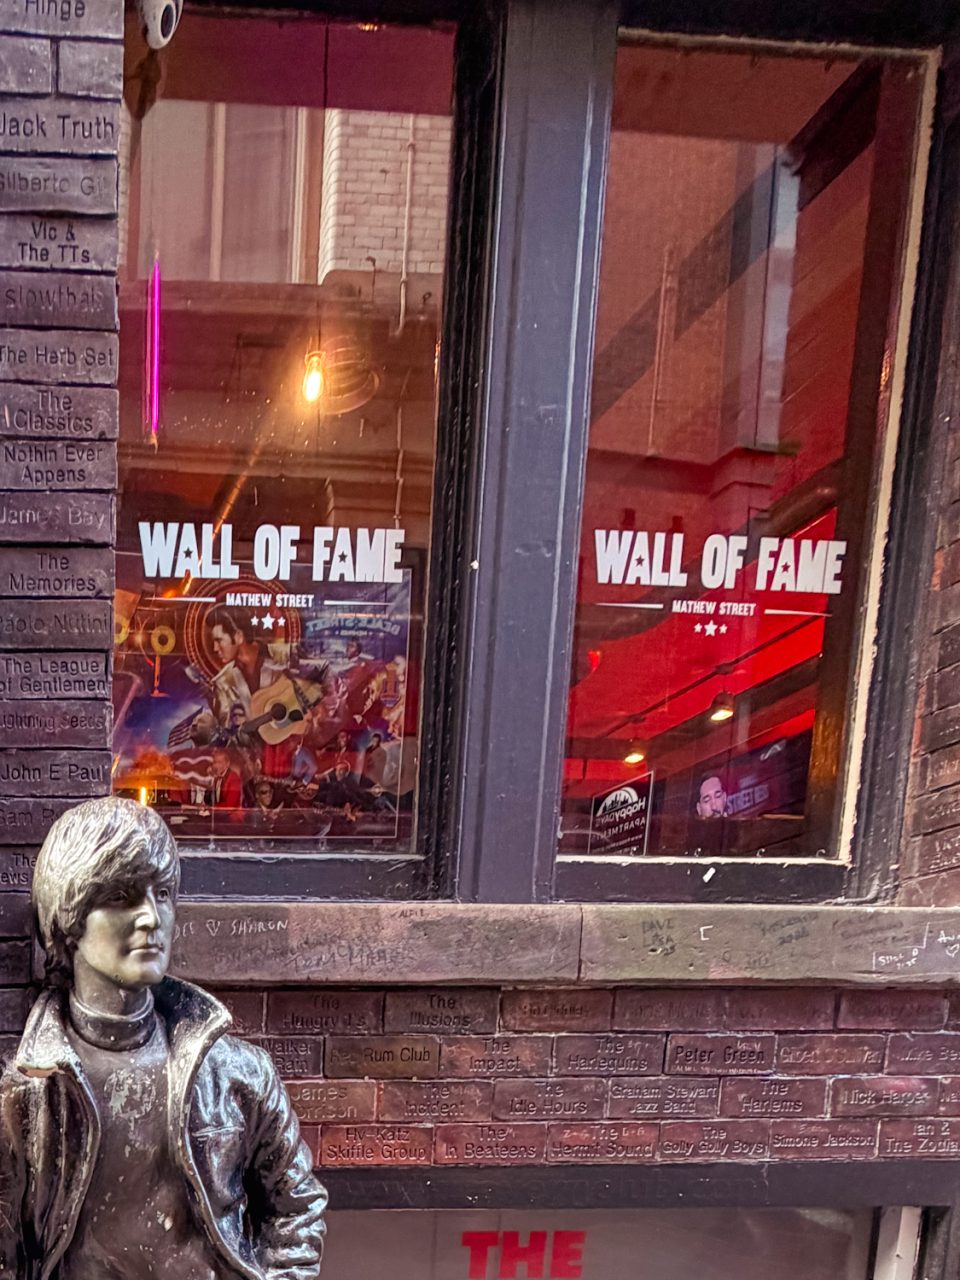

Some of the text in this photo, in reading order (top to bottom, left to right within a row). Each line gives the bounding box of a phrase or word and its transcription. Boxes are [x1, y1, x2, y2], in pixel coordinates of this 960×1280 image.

[57, 115, 115, 140] Truth
[32, 222, 76, 241] Vic &
[18, 243, 91, 263] The TTs
[35, 346, 77, 366] Herb
[84, 348, 114, 366] Set
[38, 390, 72, 411] The
[14, 408, 93, 432] Classics
[5, 446, 103, 463] Nothin Ever
[22, 466, 86, 486] Appens
[139, 522, 406, 583] WALL OF FAME
[37, 553, 70, 570] The
[594, 529, 847, 594] WALL OF FAME
[9, 573, 96, 592] Memories
[226, 593, 314, 608] MATHEW STREET
[672, 600, 757, 617] MATHEW STREET
[2, 657, 100, 677] The League
[20, 677, 107, 694] Gentlemen
[1, 764, 104, 782] John E Paul
[428, 994, 456, 1009] The
[400, 1047, 430, 1062] Club
[483, 1038, 510, 1055] The
[596, 1038, 624, 1054] The
[675, 1045, 714, 1064] Peter
[723, 1045, 766, 1065] Green
[469, 1056, 522, 1074] Impact
[568, 1055, 649, 1073] Harlequins
[423, 1084, 450, 1099] The
[536, 1081, 564, 1097] The
[612, 1085, 717, 1099] Graham Stewart
[761, 1082, 789, 1096] The
[404, 1103, 465, 1118] Incident
[509, 1099, 588, 1115] Idle Hours
[629, 1101, 696, 1114] Jazz Band
[478, 1126, 507, 1140] The
[591, 1126, 618, 1140] The
[702, 1126, 727, 1140] The
[772, 1133, 875, 1148] Simone Jackson
[327, 1144, 427, 1162] Skiffle Group
[606, 1143, 653, 1158] Sound
[663, 1141, 729, 1156] Golly Golly
[885, 1138, 913, 1153] The
[462, 1230, 586, 1280] THE
